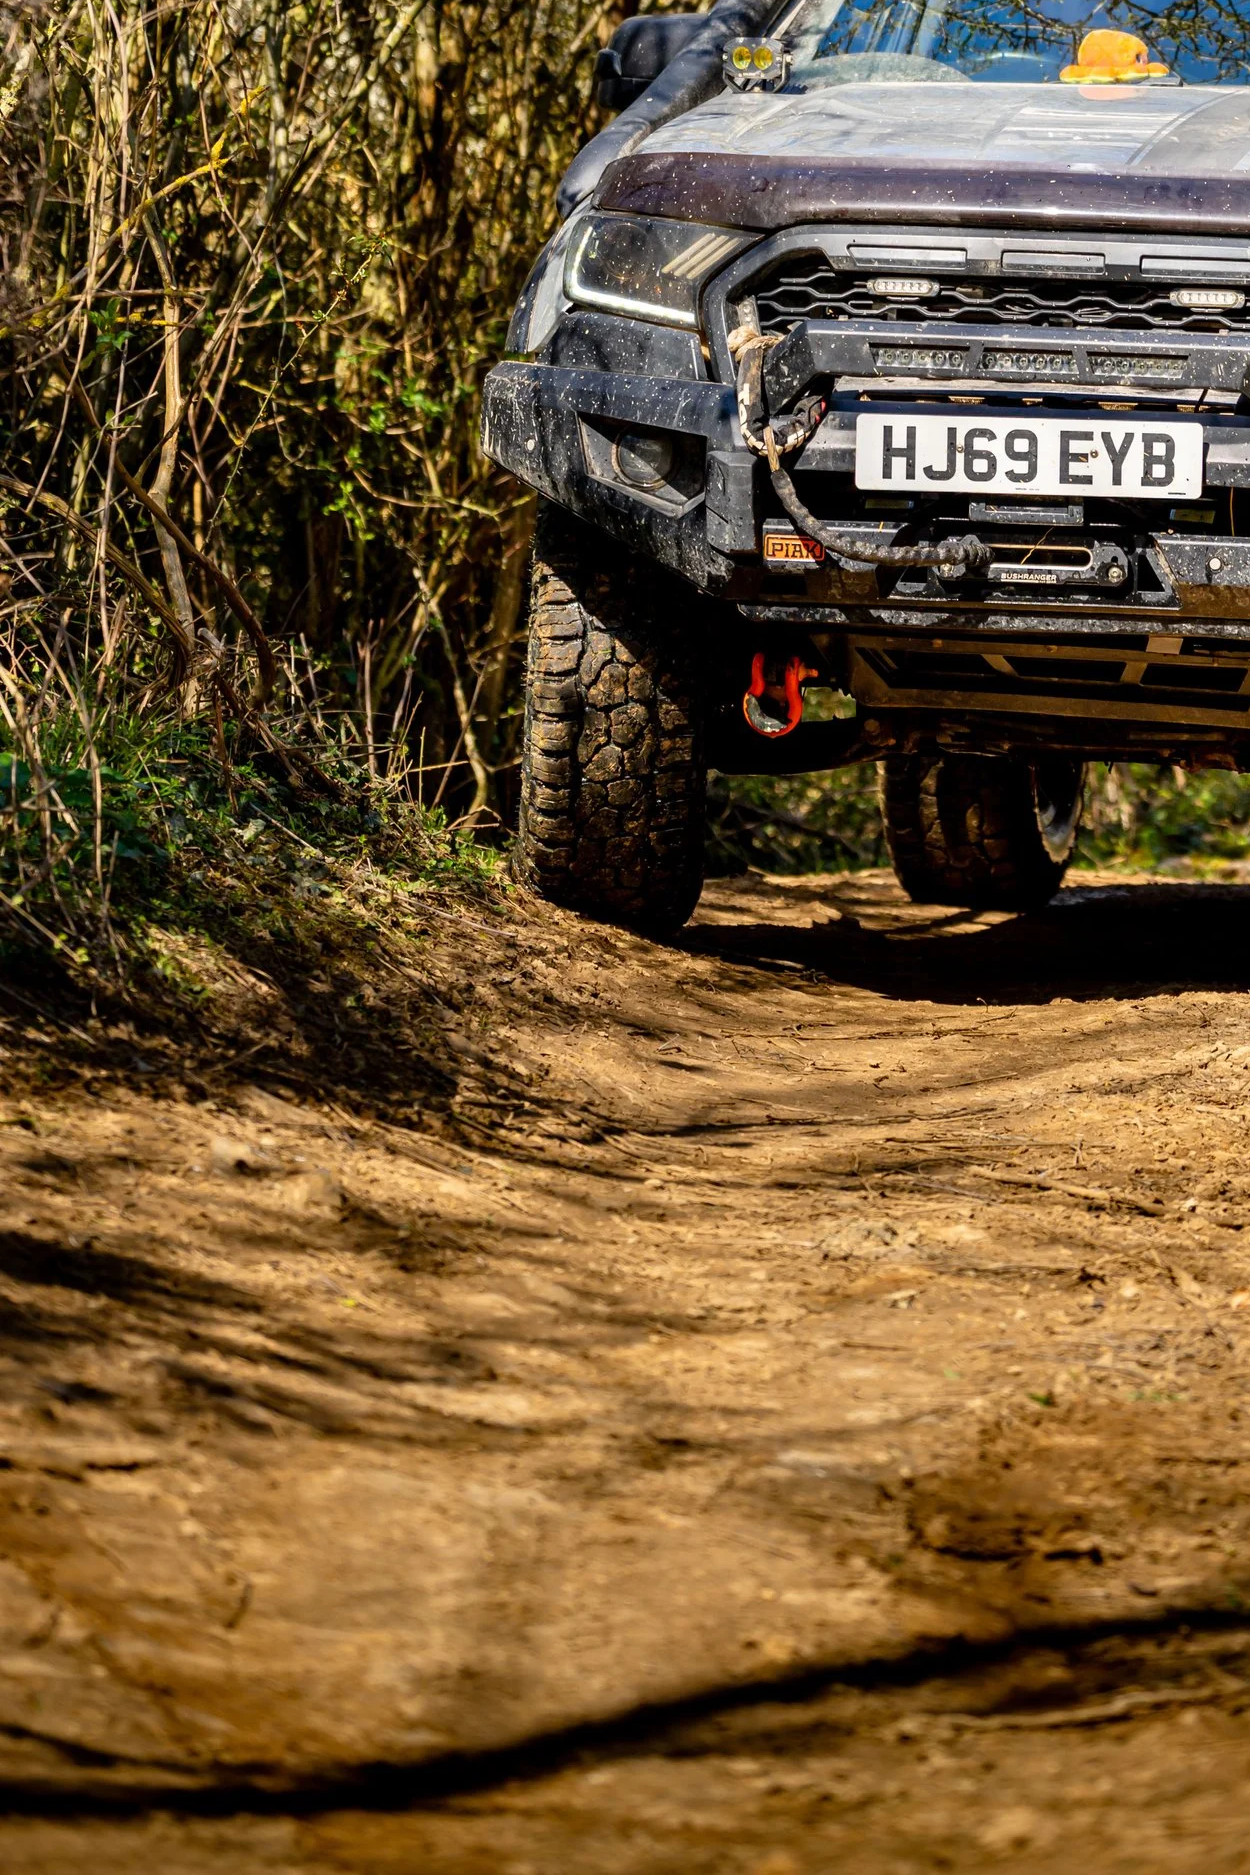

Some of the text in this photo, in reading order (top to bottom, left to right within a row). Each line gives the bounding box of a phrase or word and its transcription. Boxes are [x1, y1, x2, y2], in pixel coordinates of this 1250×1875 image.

[882, 425, 1176, 487] HJ69 EYB
[771, 542, 818, 559] PIAK
[1001, 573, 1057, 581] BUSHRANGER
